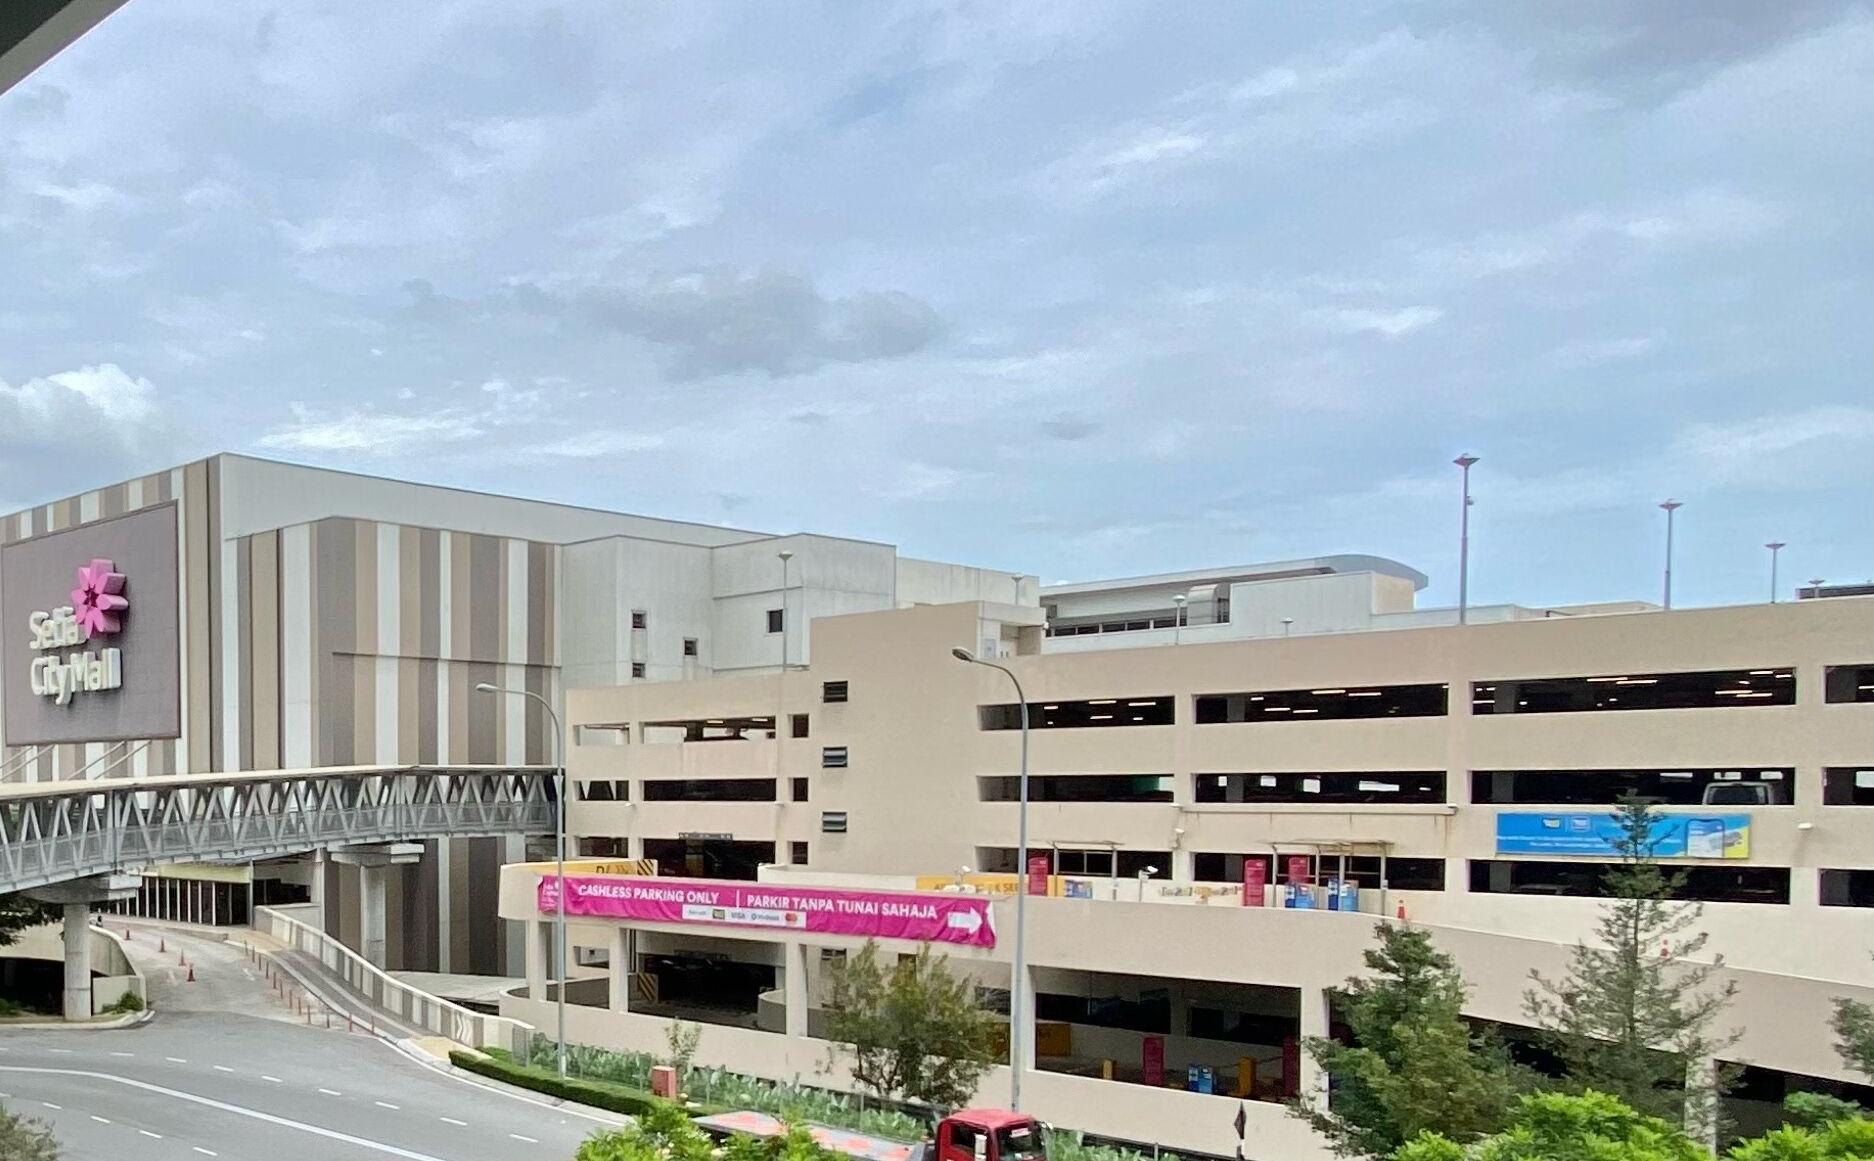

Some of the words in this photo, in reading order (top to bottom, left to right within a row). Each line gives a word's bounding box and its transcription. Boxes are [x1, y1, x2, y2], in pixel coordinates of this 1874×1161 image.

[577, 884, 632, 899] CASHLESS
[633, 887, 685, 903] PARKING
[686, 890, 720, 905] ONLY
[746, 894, 790, 909] PARKIR
[791, 897, 834, 912] TANPA
[836, 900, 879, 915] TUNAI
[881, 901, 938, 919] SAHAJA
